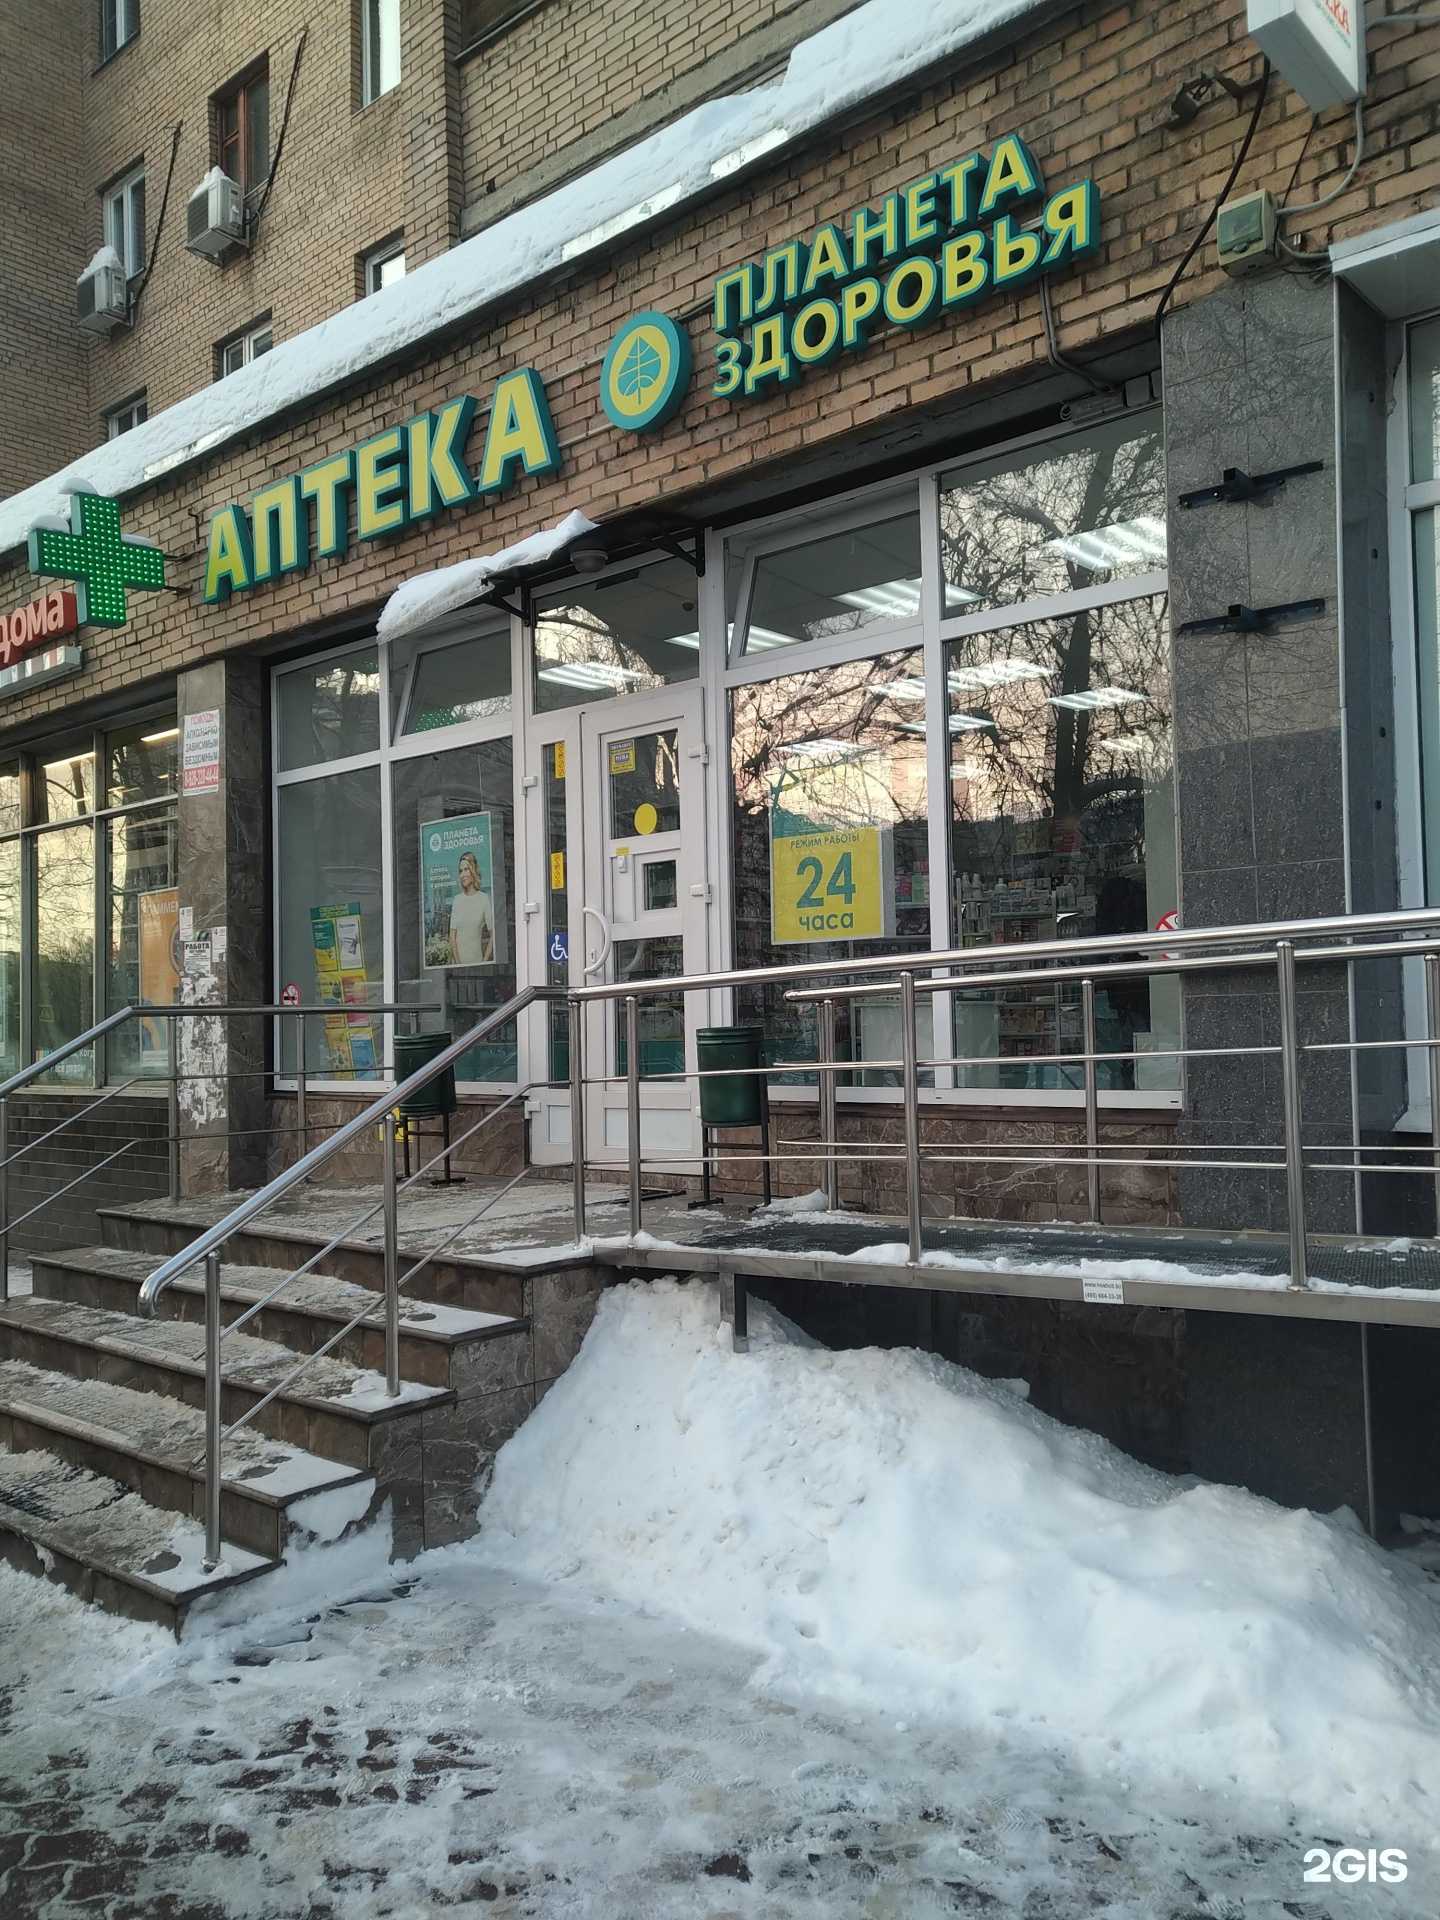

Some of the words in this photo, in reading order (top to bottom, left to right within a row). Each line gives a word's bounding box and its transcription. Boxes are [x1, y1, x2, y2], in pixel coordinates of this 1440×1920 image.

[713, 133, 1045, 337] ПЛАНЕТА
[711, 179, 1100, 397] ЗДОРОВЬЯ
[203, 367, 561, 605] АПТЕКА
[443, 826, 479, 841] ПЛАНЕТА
[790, 838, 822, 849] РЕЖИМ
[824, 833, 860, 846] РАБОТЫ
[796, 851, 856, 908] 24
[798, 912, 854, 931] часа
